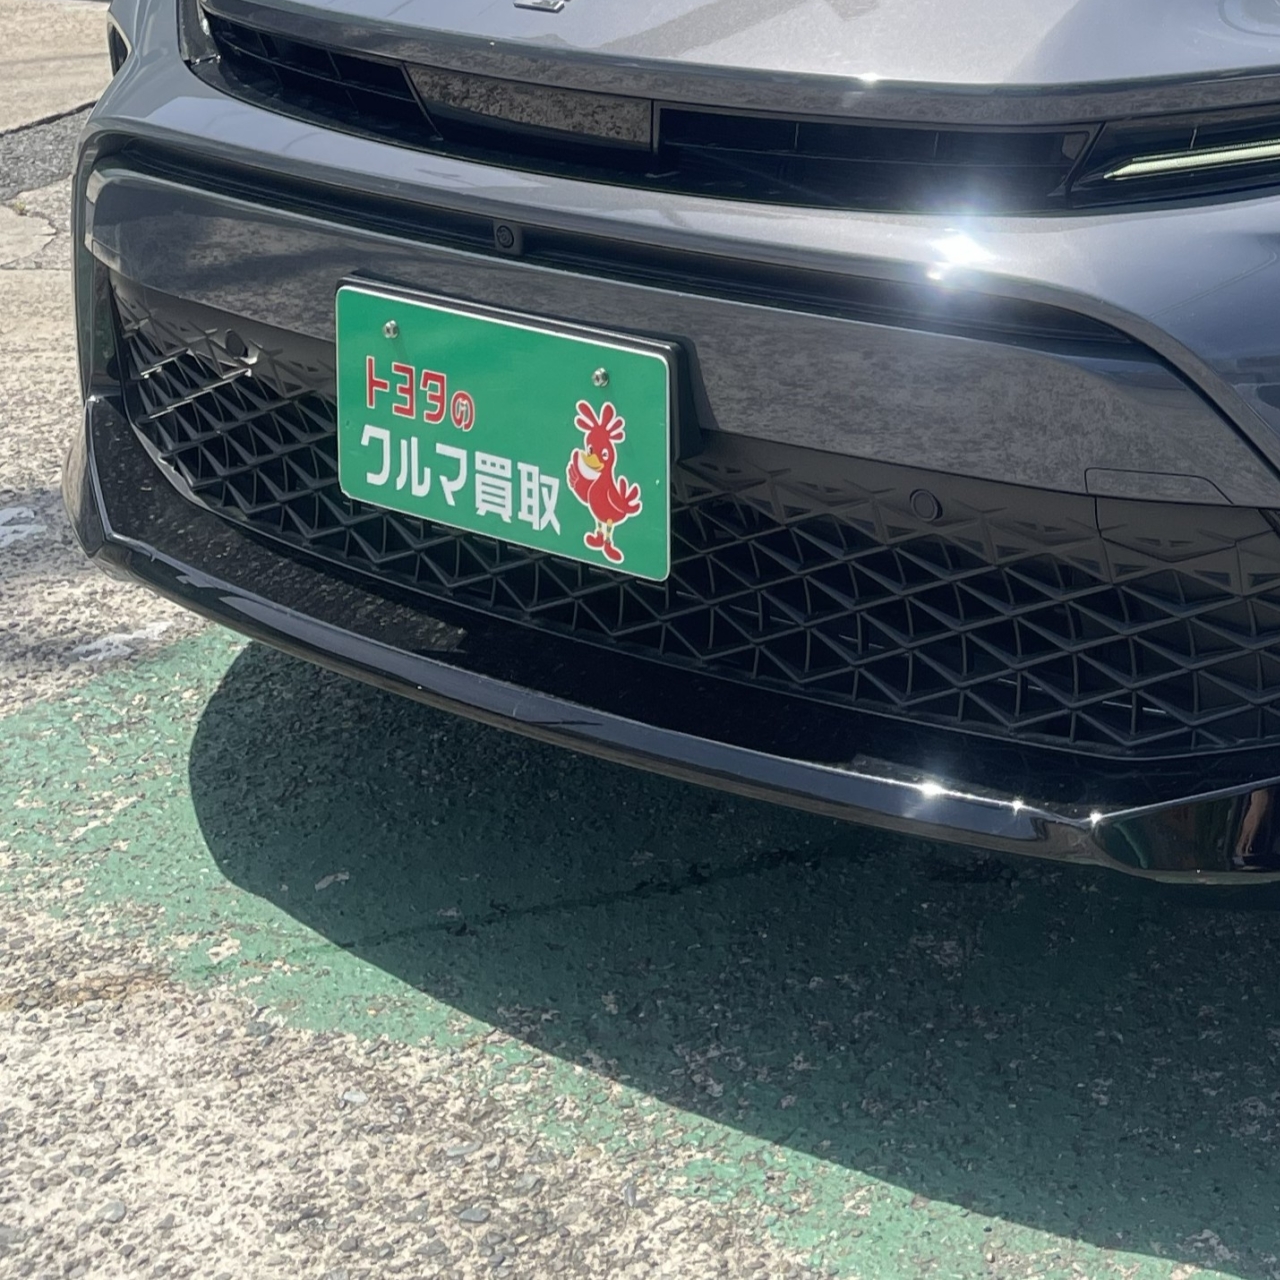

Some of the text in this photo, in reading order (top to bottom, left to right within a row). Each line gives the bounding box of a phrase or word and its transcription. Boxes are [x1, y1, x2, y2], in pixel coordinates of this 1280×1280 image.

[365, 355, 476, 432] トヨタの
[360, 424, 561, 535] クルマ買取
